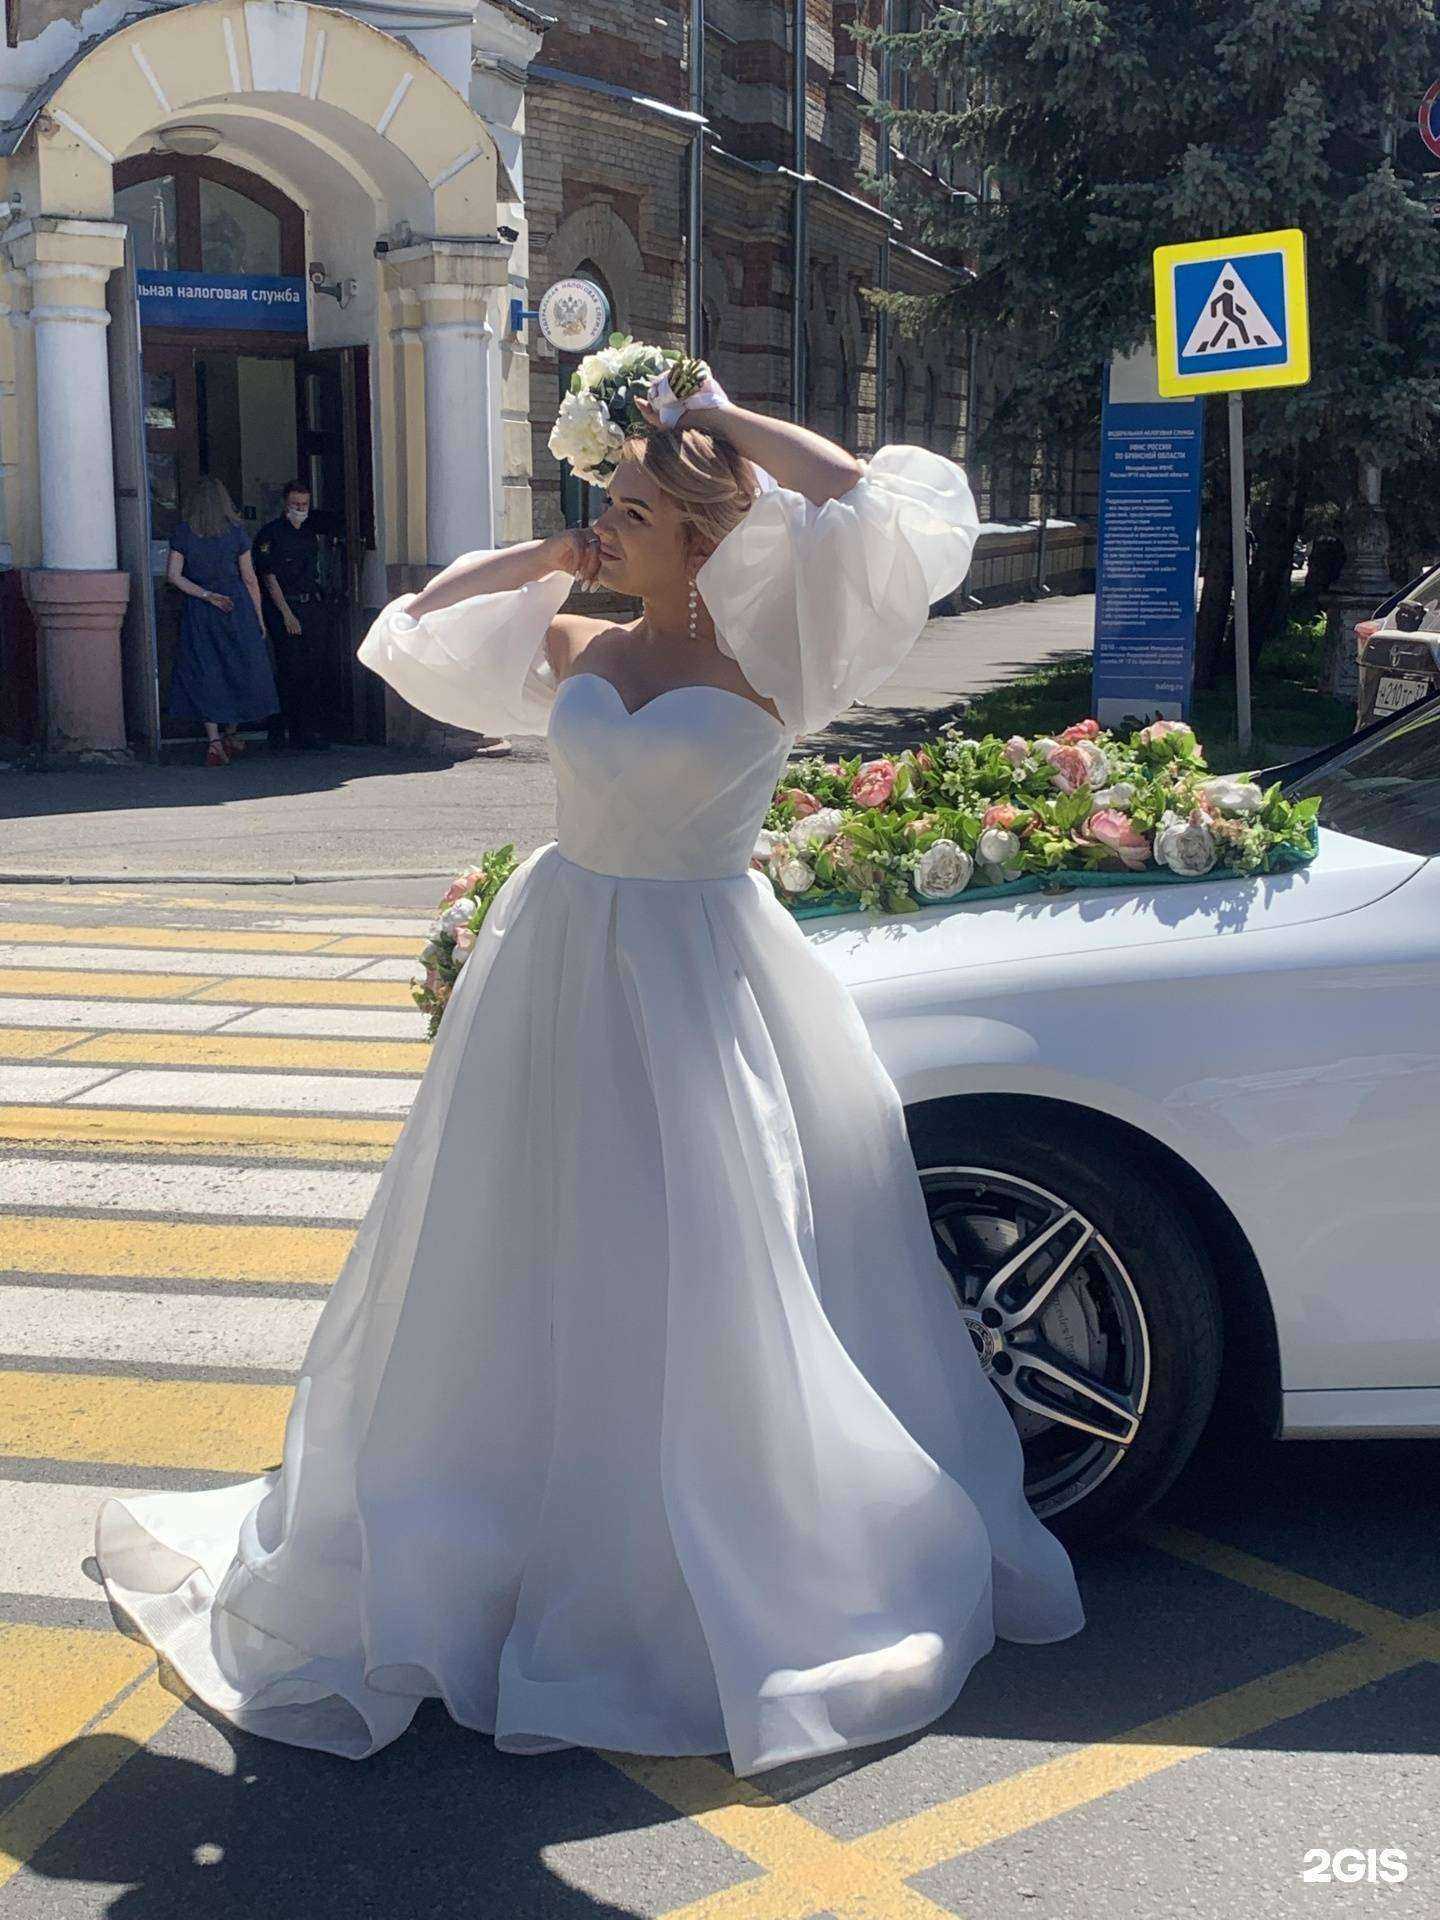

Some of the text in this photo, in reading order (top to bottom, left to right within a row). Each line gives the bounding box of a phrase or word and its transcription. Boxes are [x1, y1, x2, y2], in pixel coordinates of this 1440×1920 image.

[177, 286, 248, 300] налоговая
[251, 288, 300, 305] служба
[562, 282, 598, 303] НАЛОГОВАЯ
